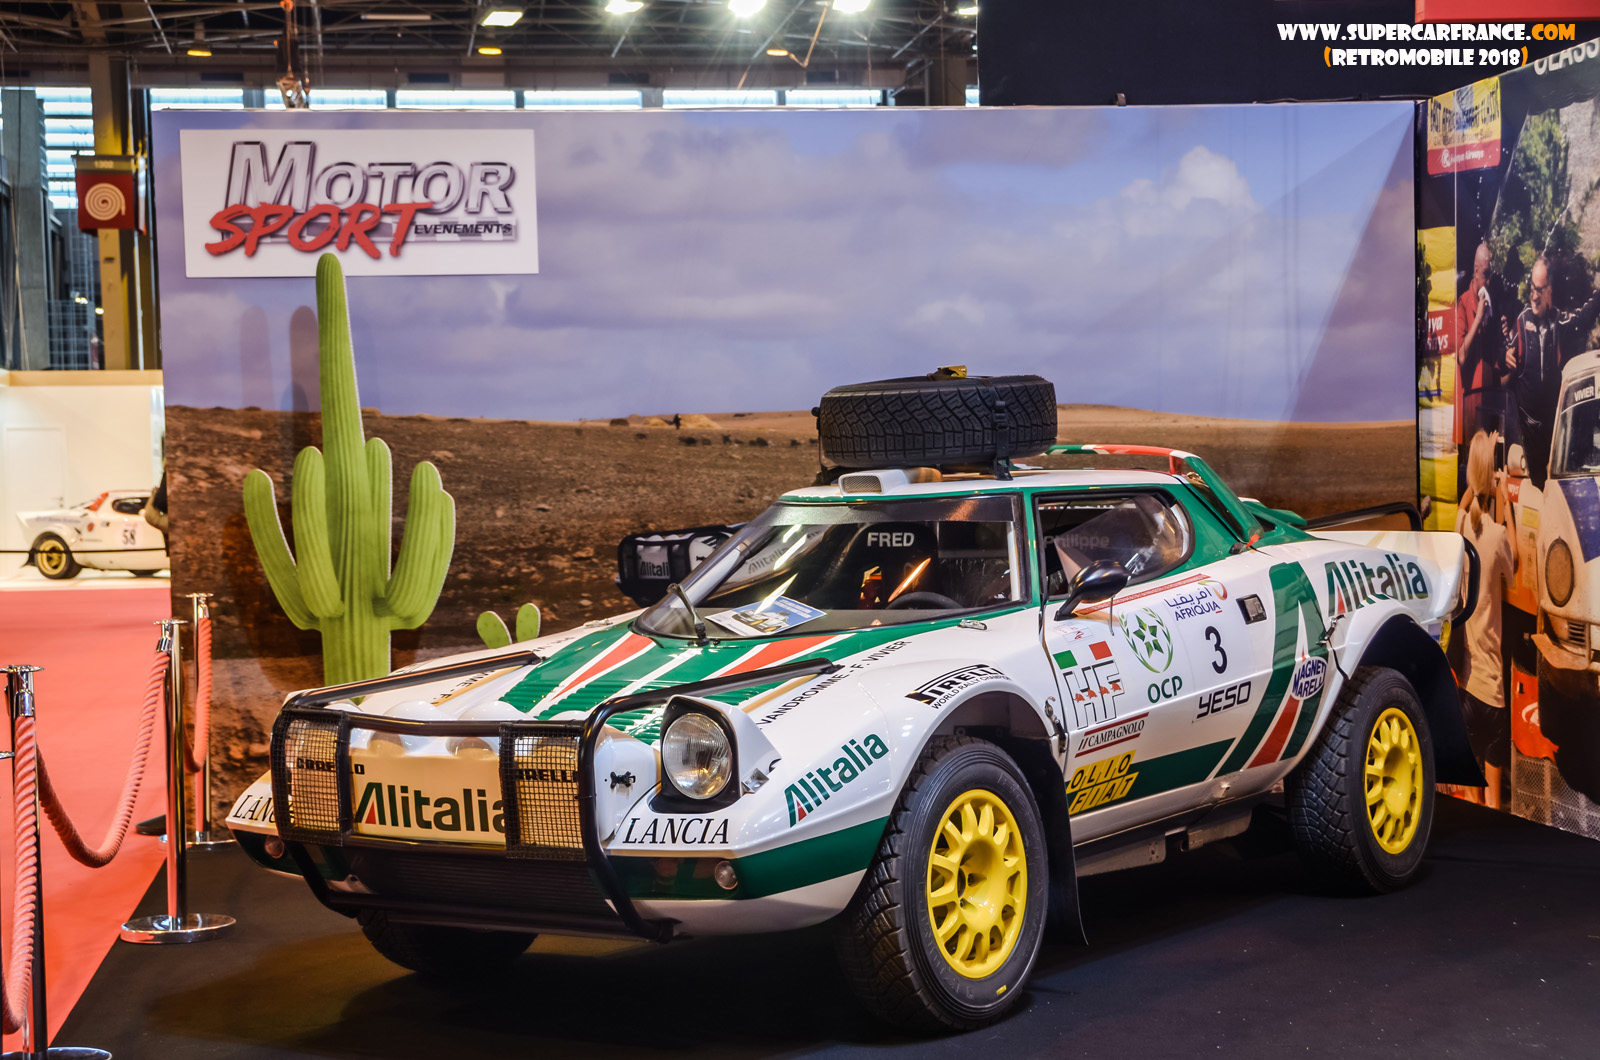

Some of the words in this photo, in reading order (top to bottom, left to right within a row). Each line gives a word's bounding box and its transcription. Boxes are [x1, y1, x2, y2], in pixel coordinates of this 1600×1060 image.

[205, 202, 434, 259] SPORT
[414, 223, 513, 235] EVENEMENTS
[122, 529, 136, 545] 58
[867, 532, 915, 547] FRED
[639, 561, 670, 576] Alitali
[1324, 553, 1429, 617] Alitalia
[1174, 600, 1222, 622] AFRIQUIA
[1204, 625, 1228, 674] 3
[931, 688, 960, 710] WORLD
[957, 676, 982, 691] RALLY
[1147, 675, 1183, 704] OCP
[1196, 682, 1251, 719] YESO
[1087, 720, 1145, 748] CAMPAGNOLO
[785, 734, 889, 828] Alitalia
[1071, 753, 1131, 788] OLIO
[1070, 776, 1134, 813] FIAT
[622, 817, 730, 845] LANCIA
